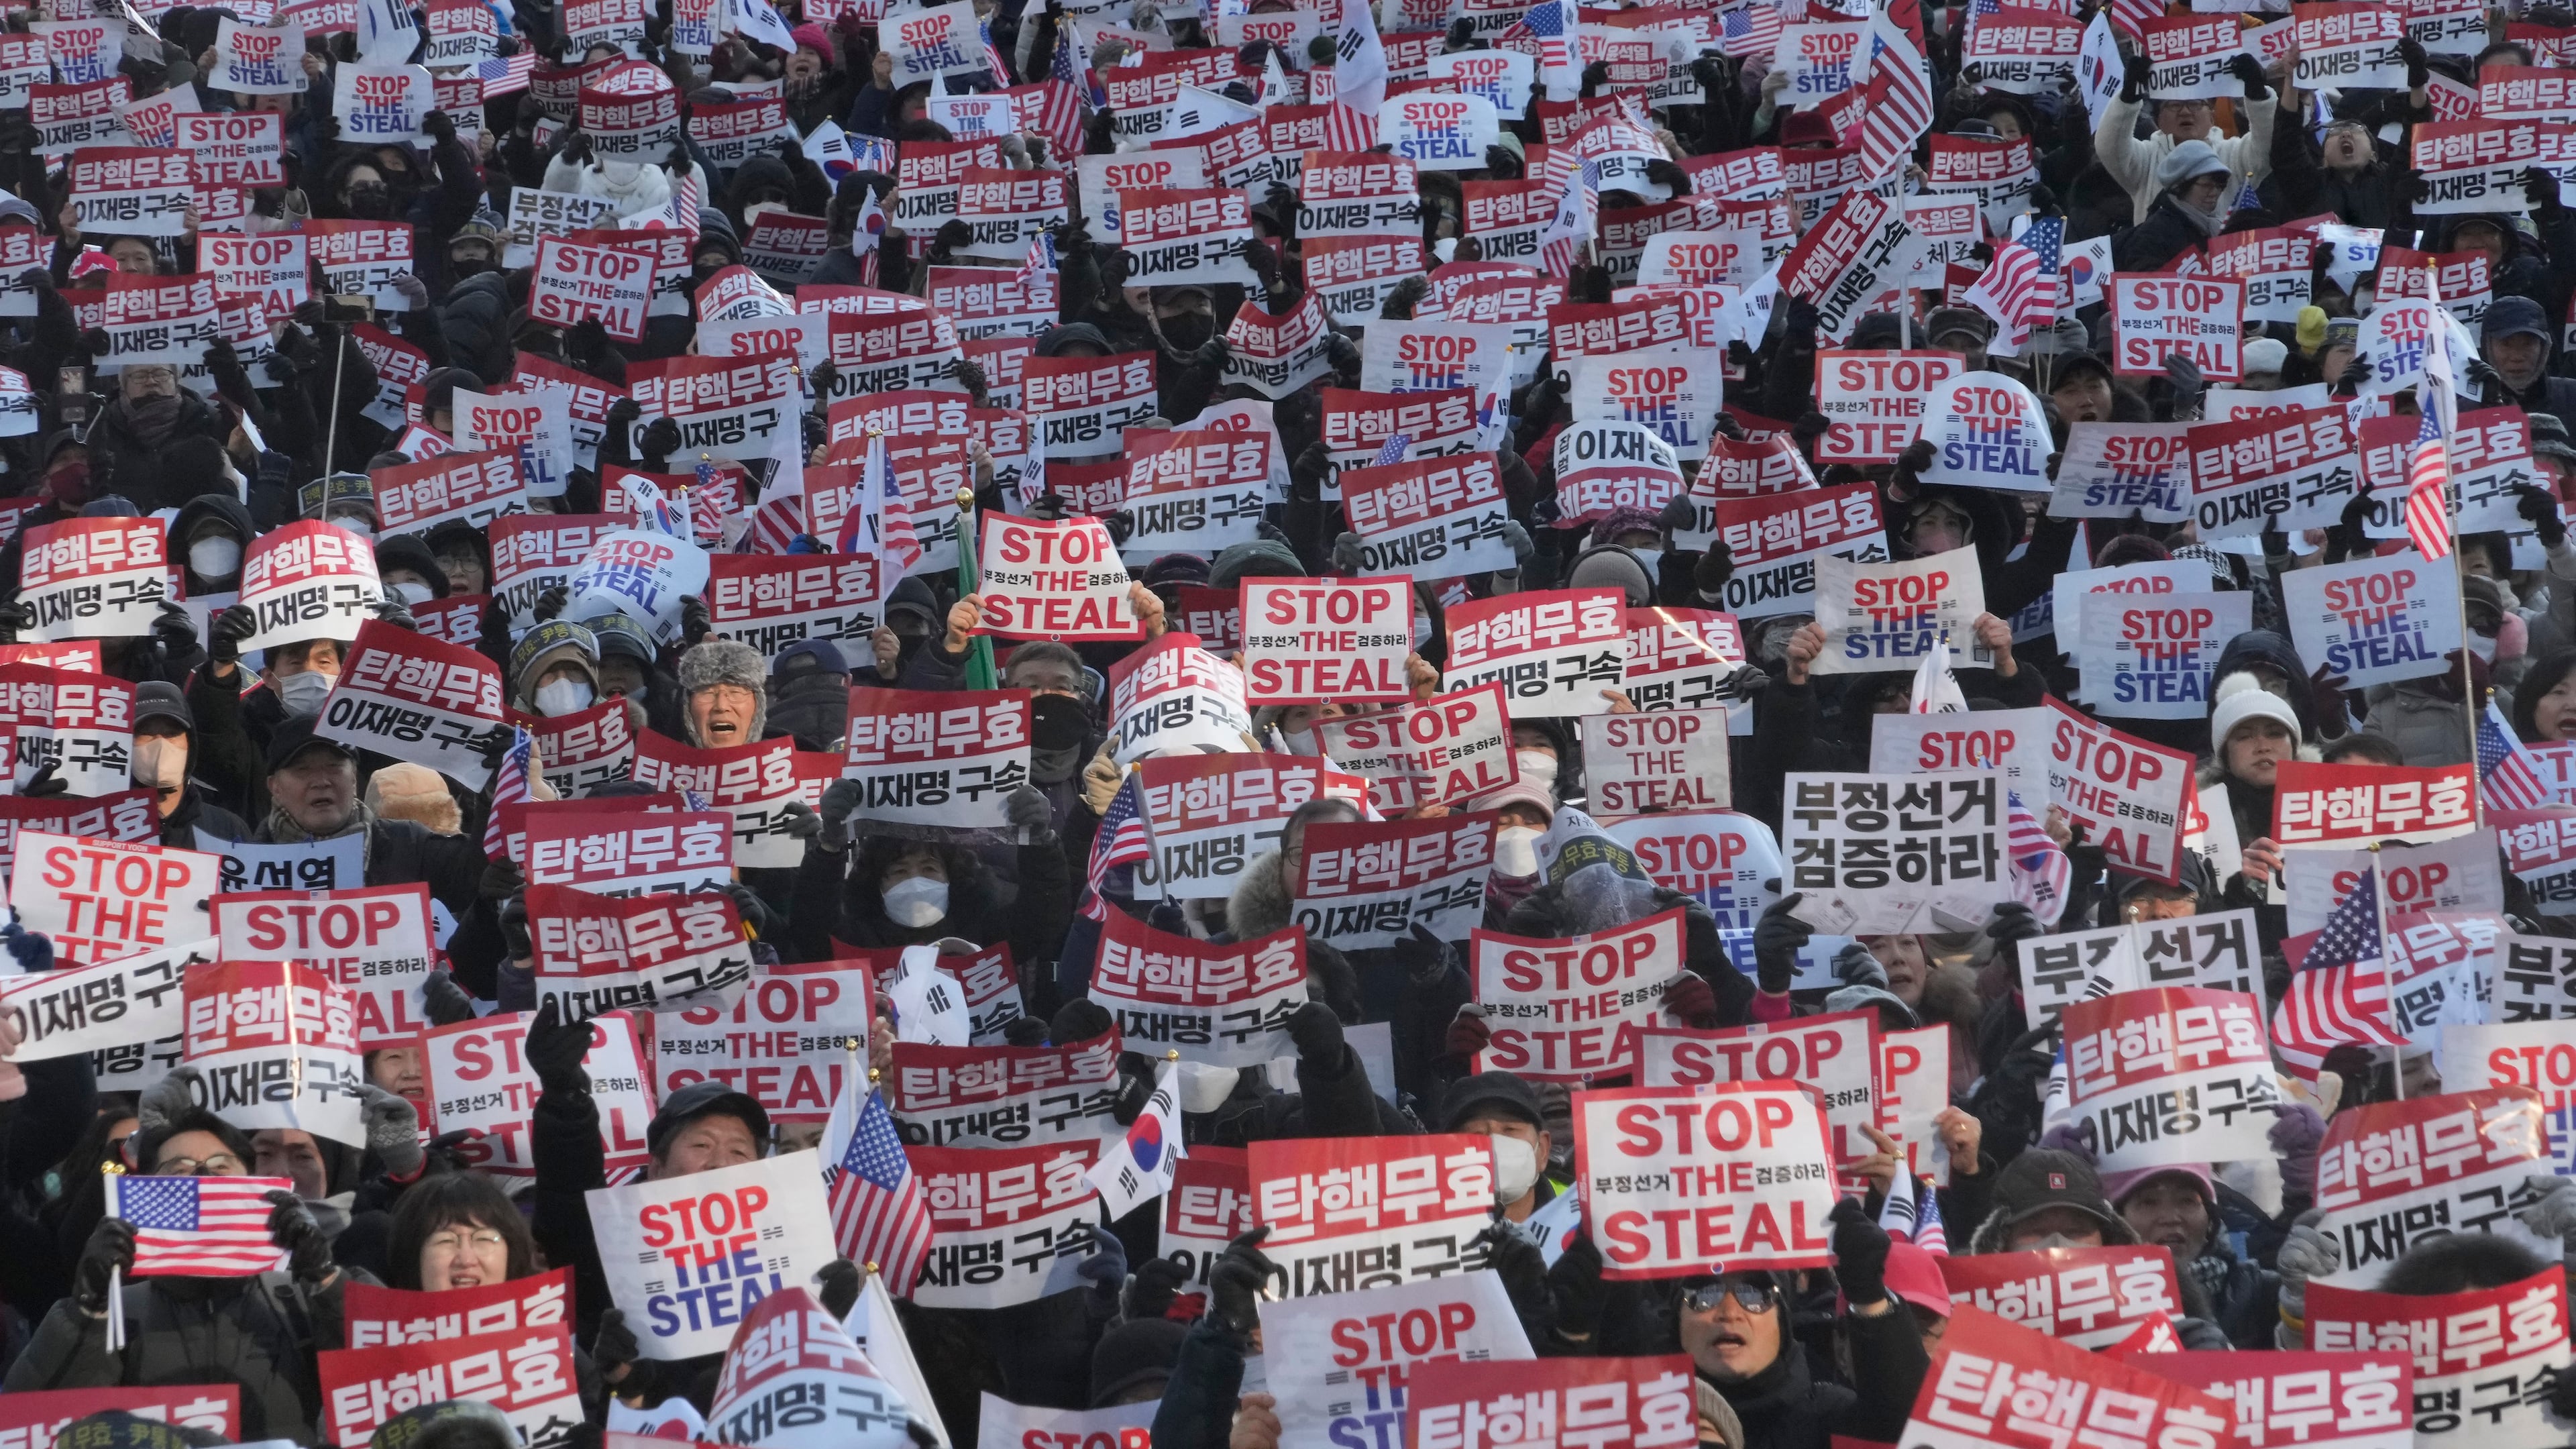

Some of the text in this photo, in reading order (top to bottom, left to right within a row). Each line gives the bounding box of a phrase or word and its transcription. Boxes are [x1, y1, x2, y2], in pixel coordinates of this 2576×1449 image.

[52, 28, 104, 47] STOP
[231, 32, 282, 53] STOP
[901, 14, 952, 41] STOP
[910, 31, 949, 56] THE
[1800, 34, 1858, 54] STOP
[1975, 27, 2079, 55] 탄핵무효
[2148, 19, 2239, 61] 탄핵무효
[2299, 12, 2402, 48] 탄핵무효
[62, 48, 99, 65] THE
[237, 52, 275, 68] THE
[904, 50, 969, 74] STEAL
[1452, 58, 1509, 76] STOP
[2296, 51, 2360, 80] 이재명
[228, 67, 289, 85] STEAL
[355, 75, 411, 94] STOP
[2149, 66, 2201, 91] 이재명
[32, 86, 131, 123] 탄핵무효
[364, 95, 402, 113] THE
[582, 91, 678, 129] 탄핵무효
[689, 102, 784, 140] 탄핵무효
[949, 102, 991, 117] STOP
[1403, 103, 1468, 120] STOP
[189, 118, 267, 141] STOP
[350, 113, 416, 133] STEAL
[957, 117, 985, 131] THE
[1415, 120, 1459, 138] THE
[213, 144, 246, 158] THE
[1400, 139, 1476, 160] STEAL
[1931, 143, 2031, 182] 탄핵무효
[2415, 125, 2538, 170] 탄핵무효
[74, 154, 191, 192] 탄핵무효
[1106, 162, 1171, 187] STOP
[1303, 164, 1417, 199] 탄핵무효
[959, 176, 1065, 215] 탄핵무효
[1124, 197, 1248, 246] 탄핵무효
[1299, 203, 1370, 230] 이재명
[1912, 208, 1972, 233] 소원은
[212, 239, 293, 266] STOP
[556, 246, 641, 281] STOP
[1788, 194, 1882, 297] 탄핵무효
[2210, 237, 2312, 276] 탄핵무효
[233, 270, 271, 286] THE
[1306, 241, 1423, 288] 탄핵무효
[1817, 218, 1912, 334] 이재명 구속
[105, 278, 216, 319] 탄핵무효
[578, 280, 614, 301] THE
[1448, 284, 1562, 323] 탄핵무효
[2133, 280, 2223, 314] STOP
[731, 329, 803, 355] STOP
[1553, 307, 1684, 362] 탄핵무효
[2162, 315, 2200, 335] THE
[1399, 335, 1477, 362] STOP
[1026, 358, 1152, 413] 탄핵무효
[1608, 367, 1688, 396] STOP
[1839, 360, 1949, 391] STOP
[472, 406, 542, 433] STOP
[1623, 396, 1678, 421] THE
[1869, 398, 1921, 417] THE
[1952, 386, 2029, 416] STOP
[1964, 416, 2023, 446] THE
[2104, 435, 2187, 462] STOP
[1128, 439, 1264, 496] 탄핵무효
[1943, 442, 2040, 476] STEAL
[2196, 413, 2347, 489] 탄핵무효
[380, 455, 520, 528] 탄핵무효
[1350, 461, 1499, 536] 탄핵무효
[2296, 468, 2353, 506] 구속
[1210, 491, 1266, 529] 구속
[1723, 491, 1879, 561] 탄핵무효
[21, 526, 162, 588] 탄핵무효
[590, 539, 674, 566] STOP
[1000, 527, 1110, 565] STOP
[1360, 528, 1446, 572] 이재명
[242, 535, 377, 602] 탄핵무효
[596, 556, 657, 581] THE
[1032, 570, 1087, 591] THE
[574, 572, 668, 617] STEAL
[716, 557, 880, 619] 탄핵무효
[1265, 588, 1391, 624] STOP
[1854, 571, 1950, 607] STOP
[2324, 568, 2416, 612] STOP
[981, 594, 1130, 630] STEAL
[1868, 604, 1937, 632] THE
[2122, 608, 2212, 641] STOP
[2341, 603, 2411, 639] THE
[1299, 631, 1356, 651] THE
[1452, 595, 1621, 667] 탄핵무효
[1555, 650, 1623, 692] 구속
[2326, 630, 2438, 675] STEAL
[349, 647, 502, 718] 탄핵무효
[1250, 659, 1401, 695] STEAL
[327, 697, 433, 743] 이재명
[849, 698, 1024, 762] 탄핵무효
[1346, 701, 1477, 750] STOP
[1607, 716, 1701, 748] STOP
[69, 737, 128, 777] 구속
[1389, 747, 1450, 771] THE
[1627, 750, 1685, 776] THE
[1919, 729, 2015, 769] STOP
[2052, 719, 2163, 792] STOP
[632, 746, 799, 805] 탄핵무효
[1602, 781, 1715, 810] STEAL
[1792, 777, 1997, 833] 부정선거
[2066, 775, 2118, 818] THE
[2281, 775, 2469, 840] 탄핵무효
[531, 820, 725, 884] 탄핵무효
[1307, 820, 1493, 898] 탄핵무효
[1633, 833, 1747, 873] STOP
[1792, 833, 2000, 890] 검증하라
[42, 846, 191, 900] STOP
[58, 892, 168, 945] THE
[246, 901, 400, 951] STOP
[538, 900, 737, 973] 탄핵무효
[362, 958, 427, 978] 검증하라
[1503, 932, 1657, 992] STOP
[189, 985, 357, 1055] 탄핵무효
[1548, 989, 1620, 1024] THE
[726, 1031, 799, 1059] THE
[2070, 1002, 2263, 1099] 탄핵무효
[901, 1033, 1118, 1110] 탄핵무효
[1615, 1097, 1794, 1157] STOP
[1260, 1146, 1494, 1246] 탄핵무효
[1595, 1169, 1670, 1193] 부정선거
[1670, 1161, 1754, 1199] THE
[1756, 1163, 1827, 1186] 검증하라
[639, 1185, 769, 1248] STOP
[1604, 1201, 1828, 1265] STEAL
[664, 1232, 763, 1287] THE
[1331, 1302, 1476, 1367] STOP
